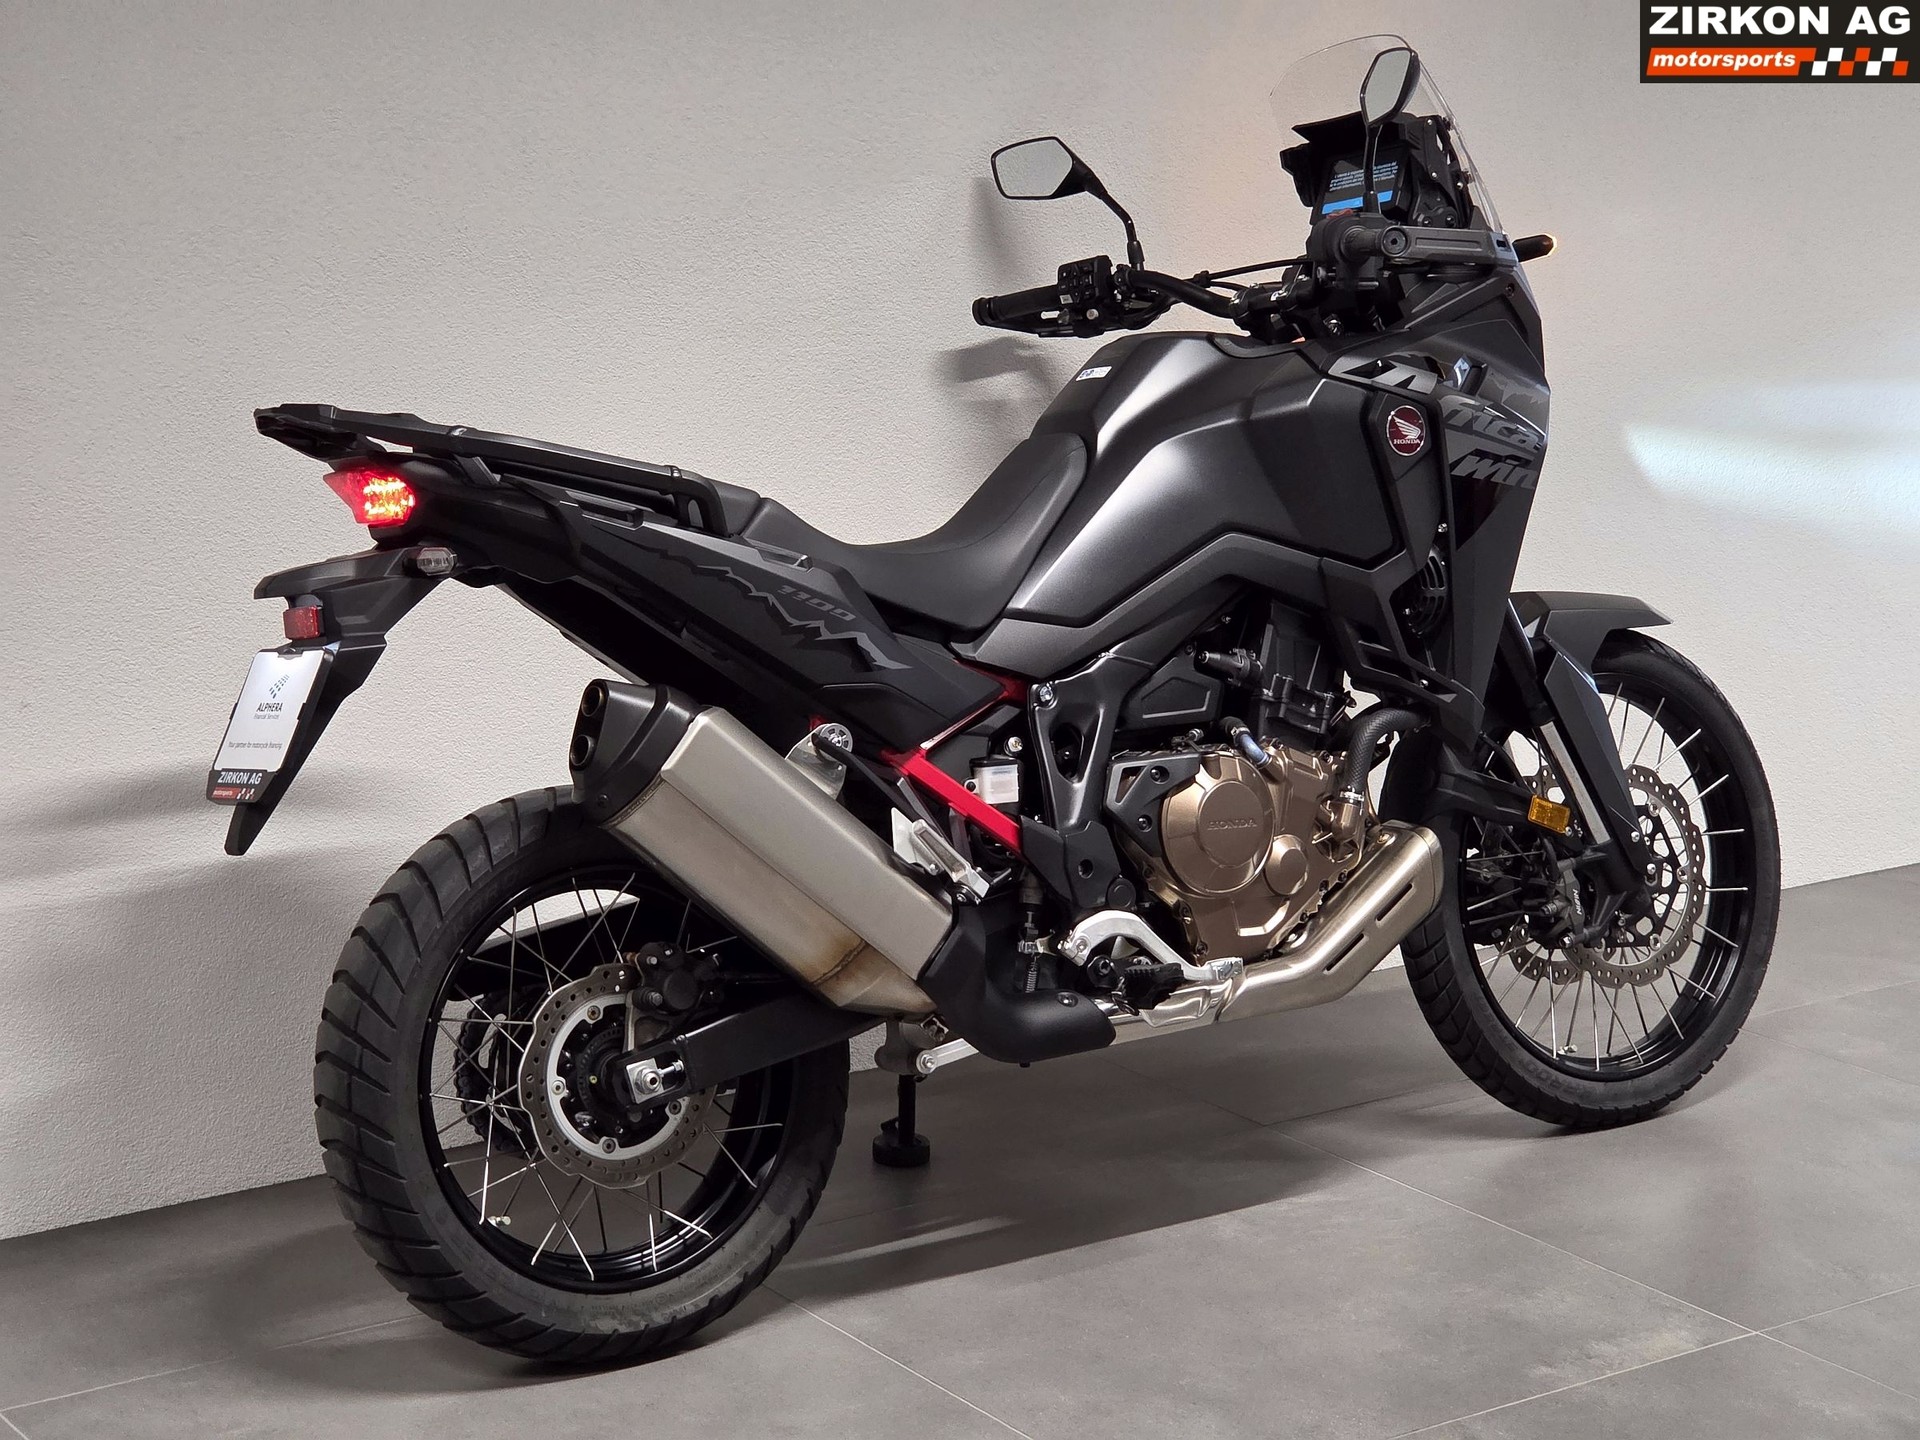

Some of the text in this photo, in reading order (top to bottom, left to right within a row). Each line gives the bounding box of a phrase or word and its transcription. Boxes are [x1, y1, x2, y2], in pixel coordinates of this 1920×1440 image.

[256, 702, 283, 712] ALPHERA
[217, 771, 263, 785] ZIRKON AG
[1207, 818, 1258, 831] HONDA
